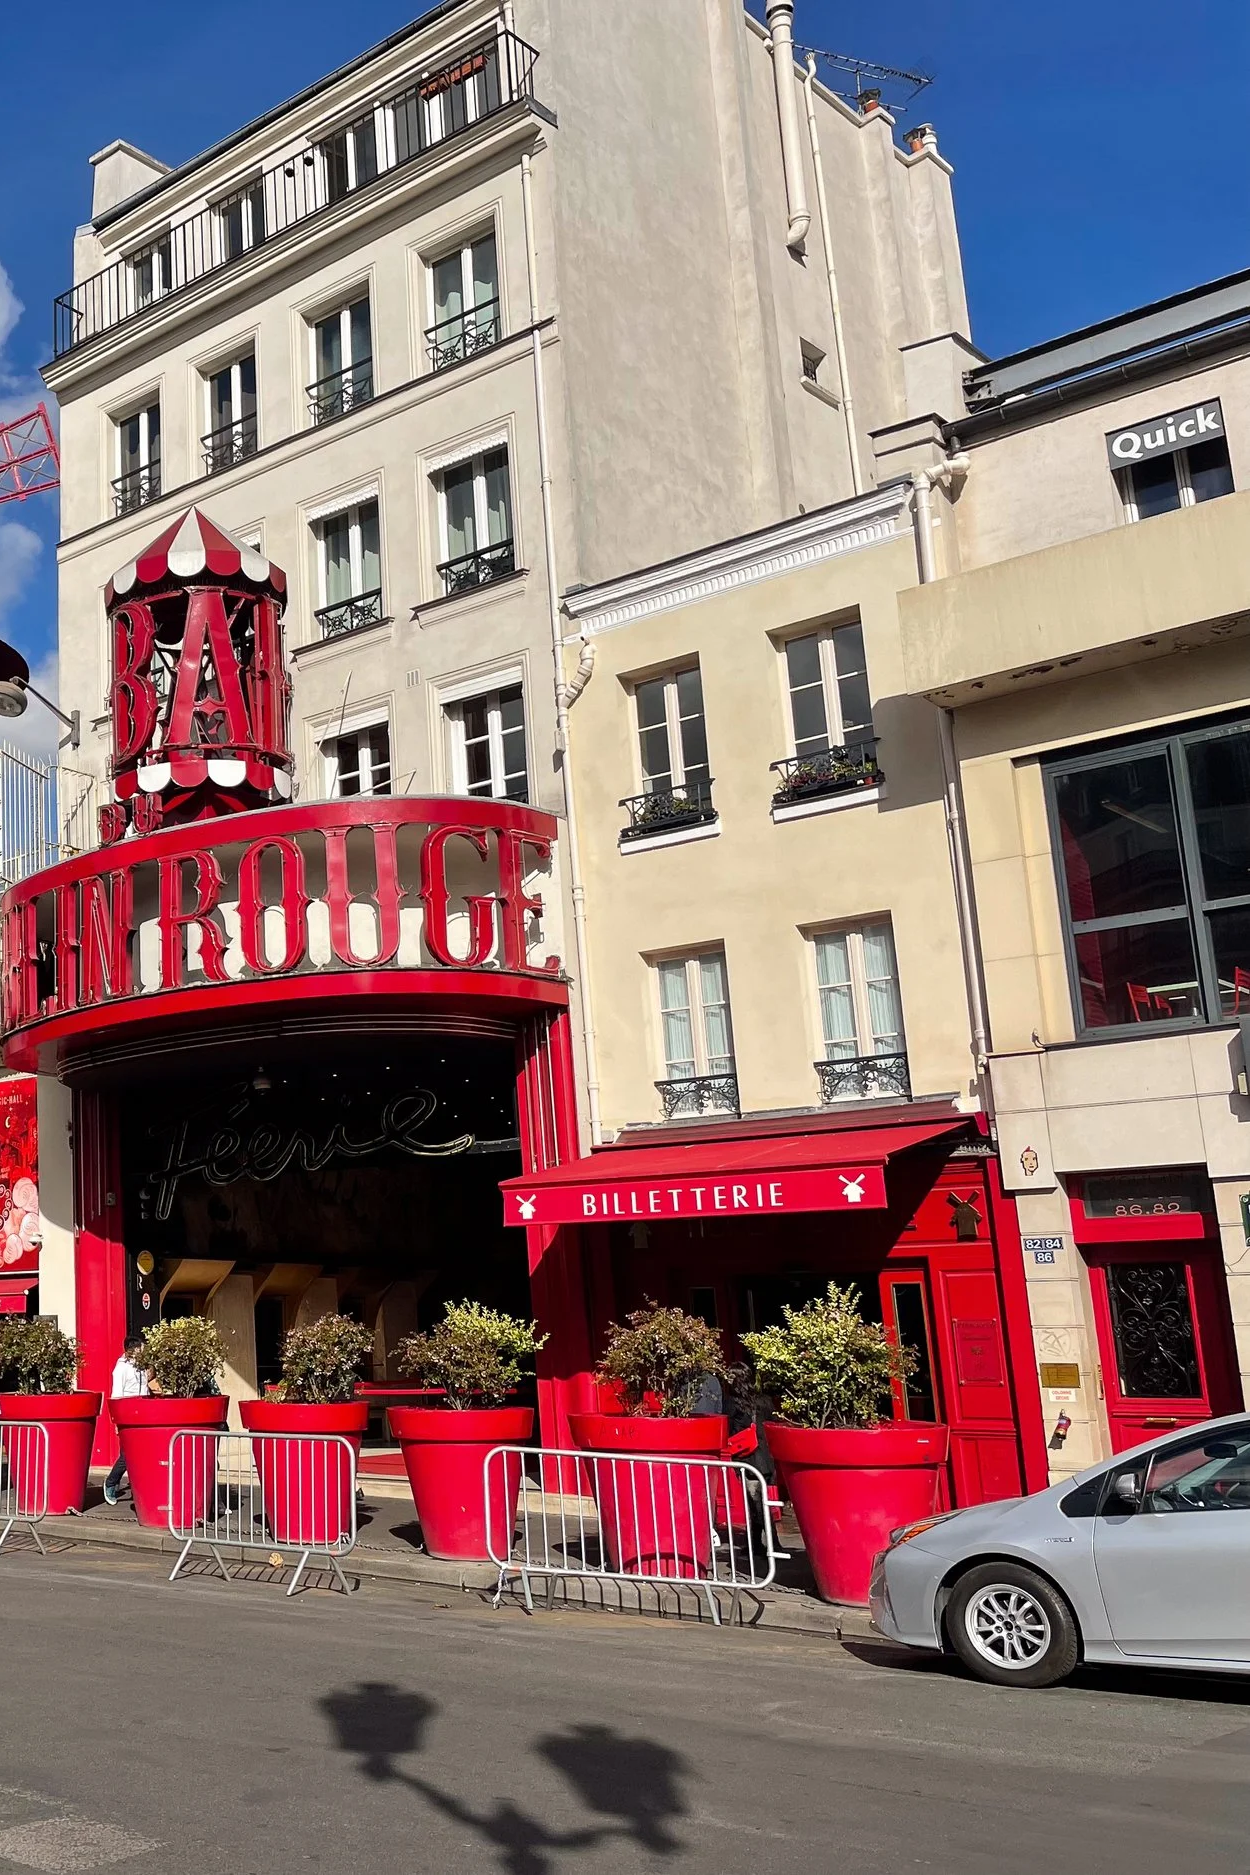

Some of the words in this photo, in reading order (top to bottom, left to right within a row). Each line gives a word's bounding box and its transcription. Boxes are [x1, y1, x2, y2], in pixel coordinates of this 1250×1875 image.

[1112, 407, 1221, 459] Quick
[111, 586, 290, 764] BAR
[156, 822, 562, 990] ROUGE
[582, 1182, 784, 1216] BILLETTERIE
[1025, 1239, 1042, 1249] 82
[1045, 1238, 1062, 1249] 84
[1037, 1252, 1053, 1263] 86
